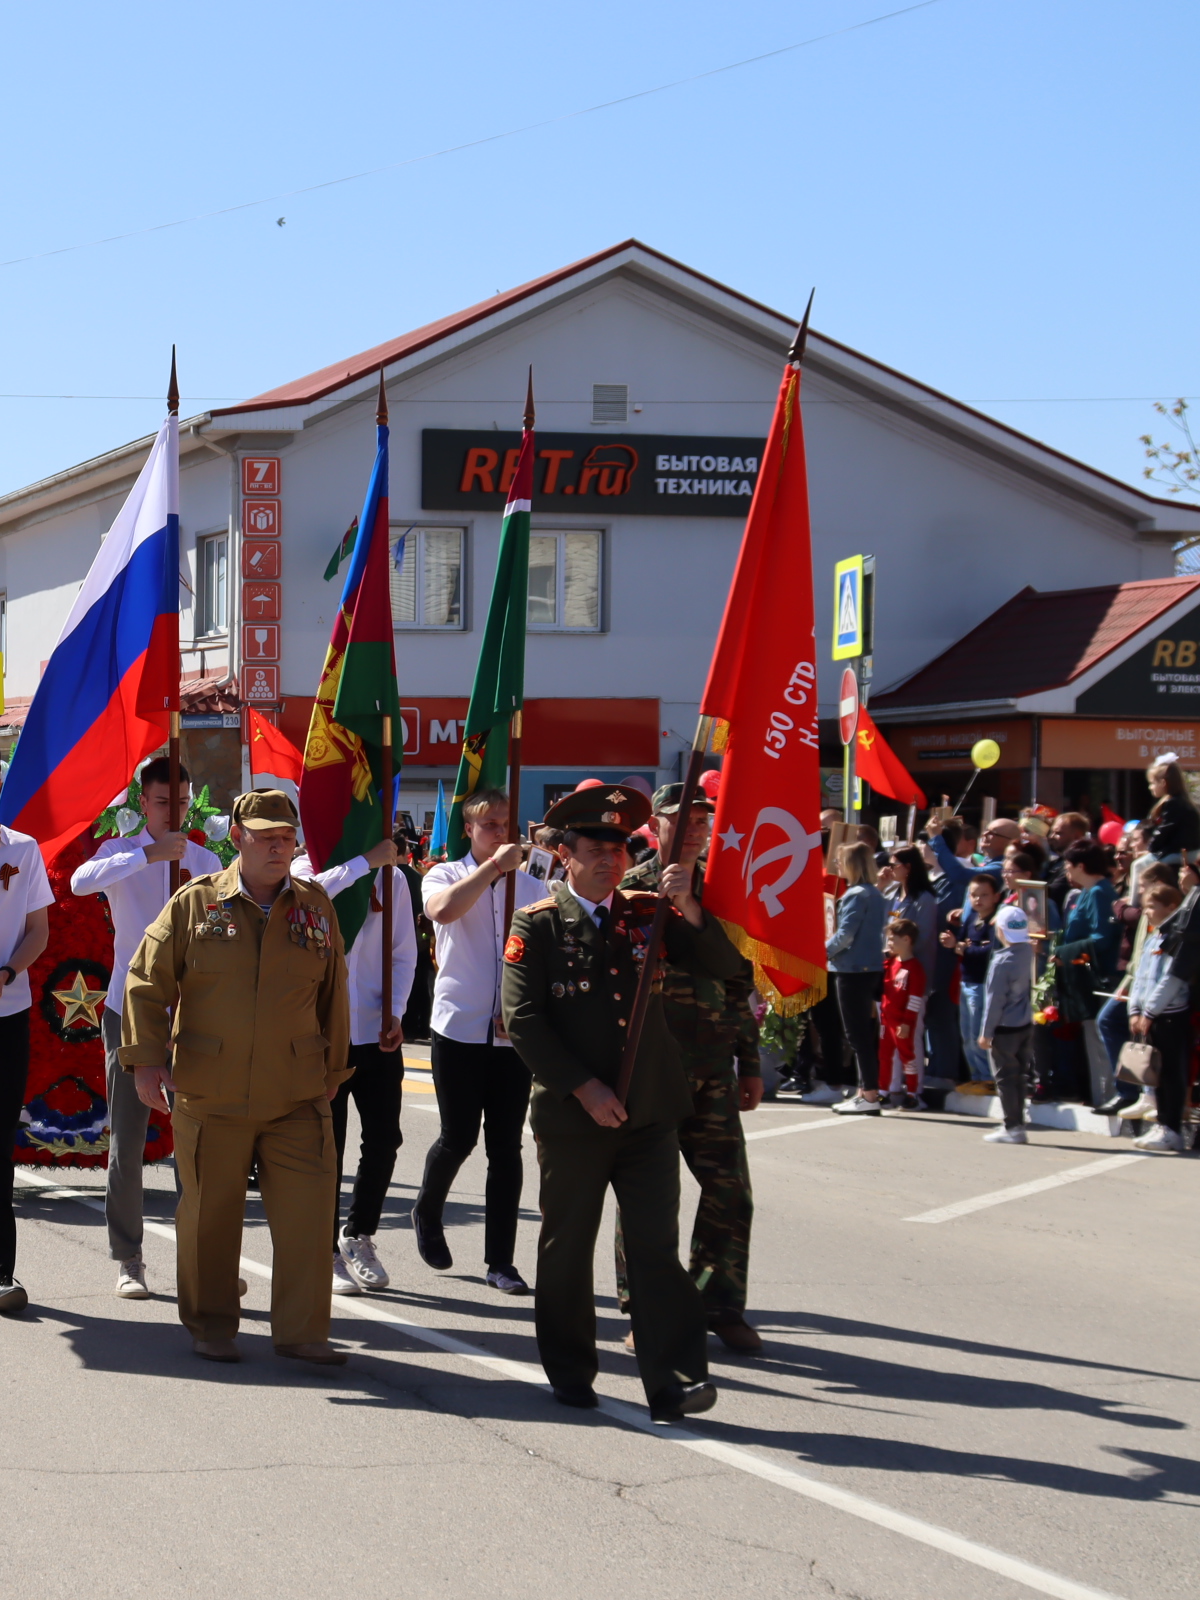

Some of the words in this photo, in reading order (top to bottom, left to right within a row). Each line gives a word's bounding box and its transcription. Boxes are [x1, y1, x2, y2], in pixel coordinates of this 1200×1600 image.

[253, 462, 271, 482] 7
[656, 454, 758, 473] БЫТОВАЯ
[655, 478, 753, 496] ТЕХНИКА
[1152, 639, 1200, 668] RB
[225, 716, 239, 726] 230
[763, 711, 795, 760] 150
[1116, 728, 1196, 742] ВЫГОДНЫЕ
